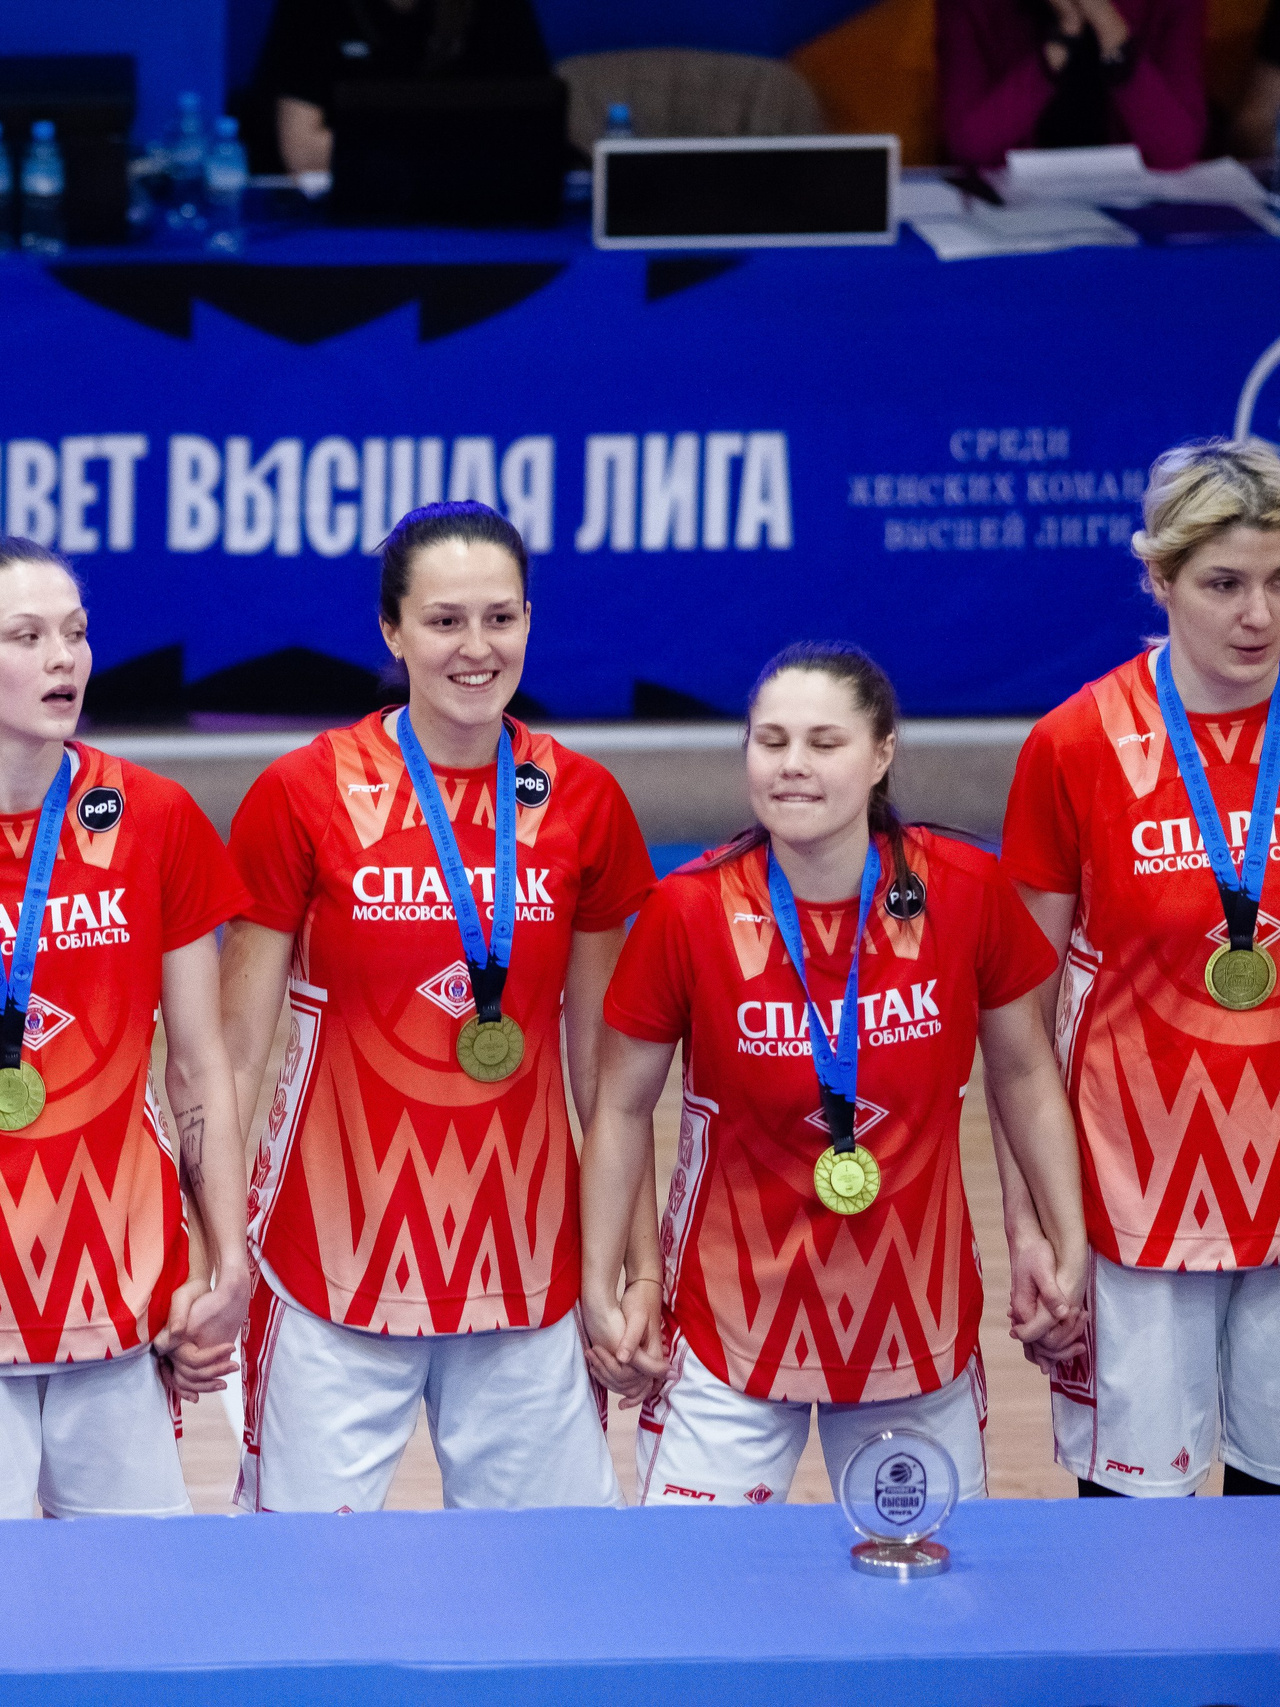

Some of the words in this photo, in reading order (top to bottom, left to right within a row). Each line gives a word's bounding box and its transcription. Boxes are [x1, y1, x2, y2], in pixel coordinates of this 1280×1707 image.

[166, 434, 554, 557] ВЫСШАЯ
[574, 432, 793, 553] ЛИГА
[1025, 470, 1146, 502] КОМАН
[515, 777, 545, 792] РФБ
[85, 799, 117, 818] РФБ
[352, 866, 555, 904] СПАТК
[352, 904, 462, 923] МОСКОВСК
[485, 905, 555, 922] ОАСТЬ
[55, 927, 131, 950] ОБЛАСТЬ
[737, 979, 940, 1039] СПАТАК
[868, 1019, 942, 1047] ОБЛАСТЬ
